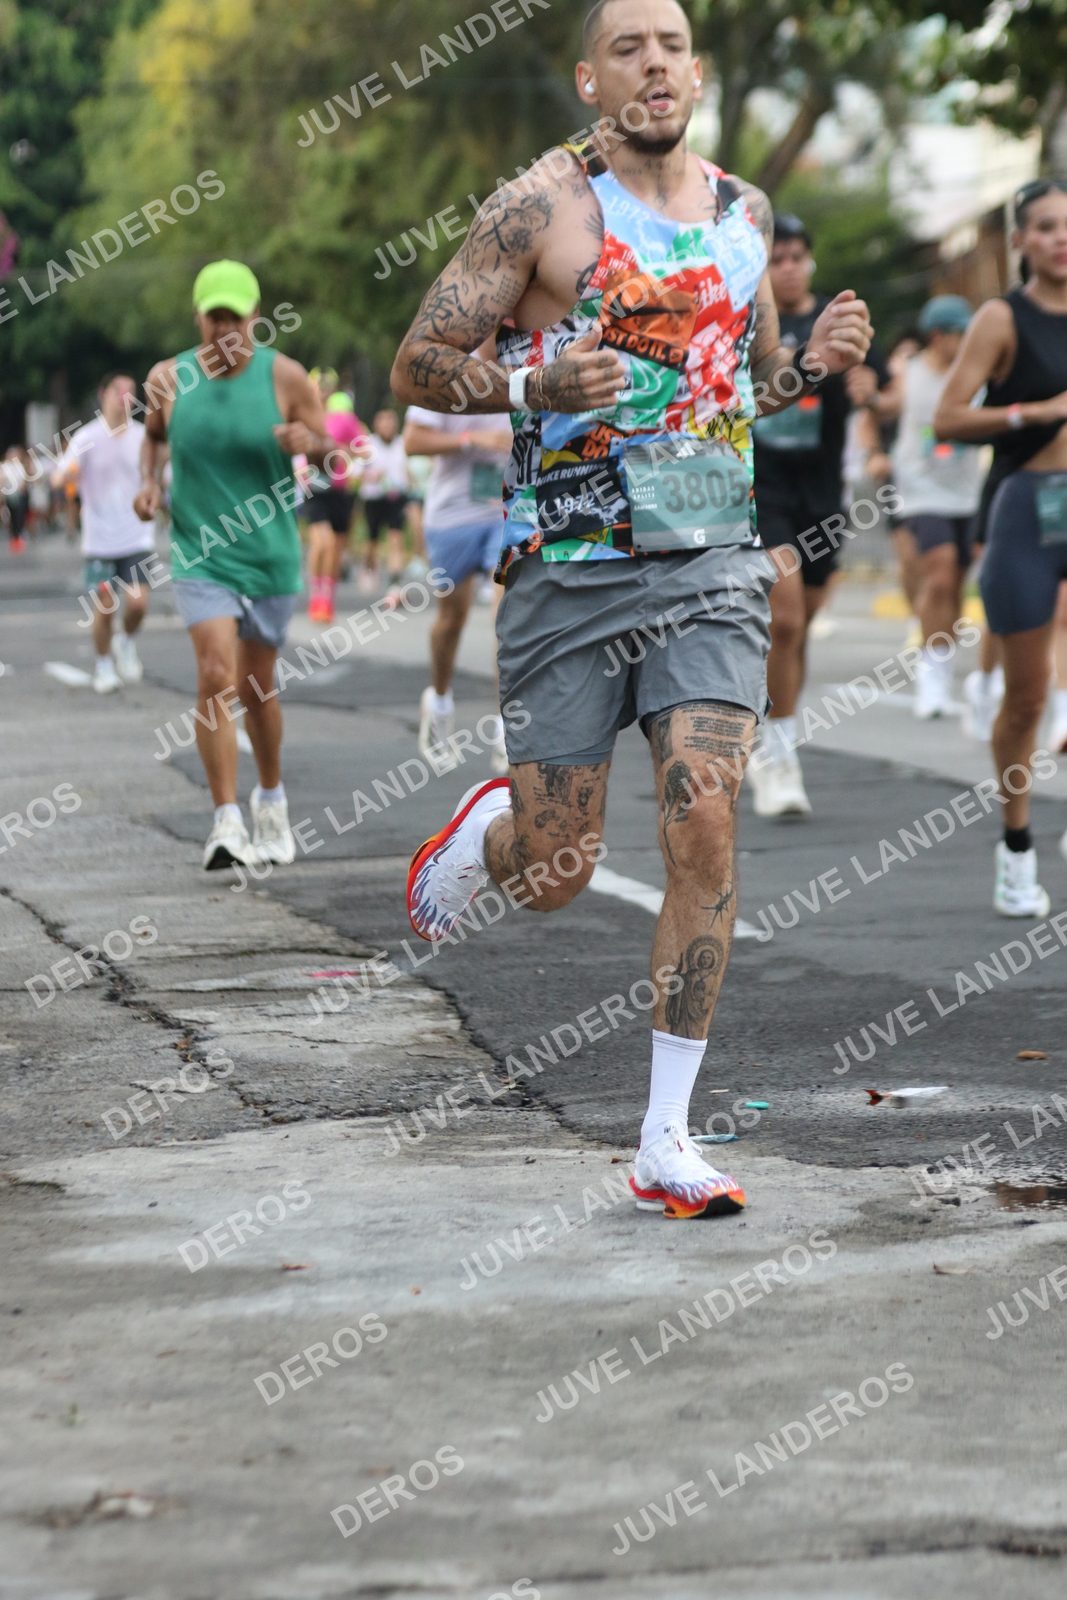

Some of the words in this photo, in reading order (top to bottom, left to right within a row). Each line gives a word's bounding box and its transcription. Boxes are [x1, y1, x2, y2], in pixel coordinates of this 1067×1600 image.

[626, 334, 649, 353] DO
[536, 471, 560, 487] NIKE
[662, 467, 747, 514] 3805
[555, 491, 595, 515] 1972
